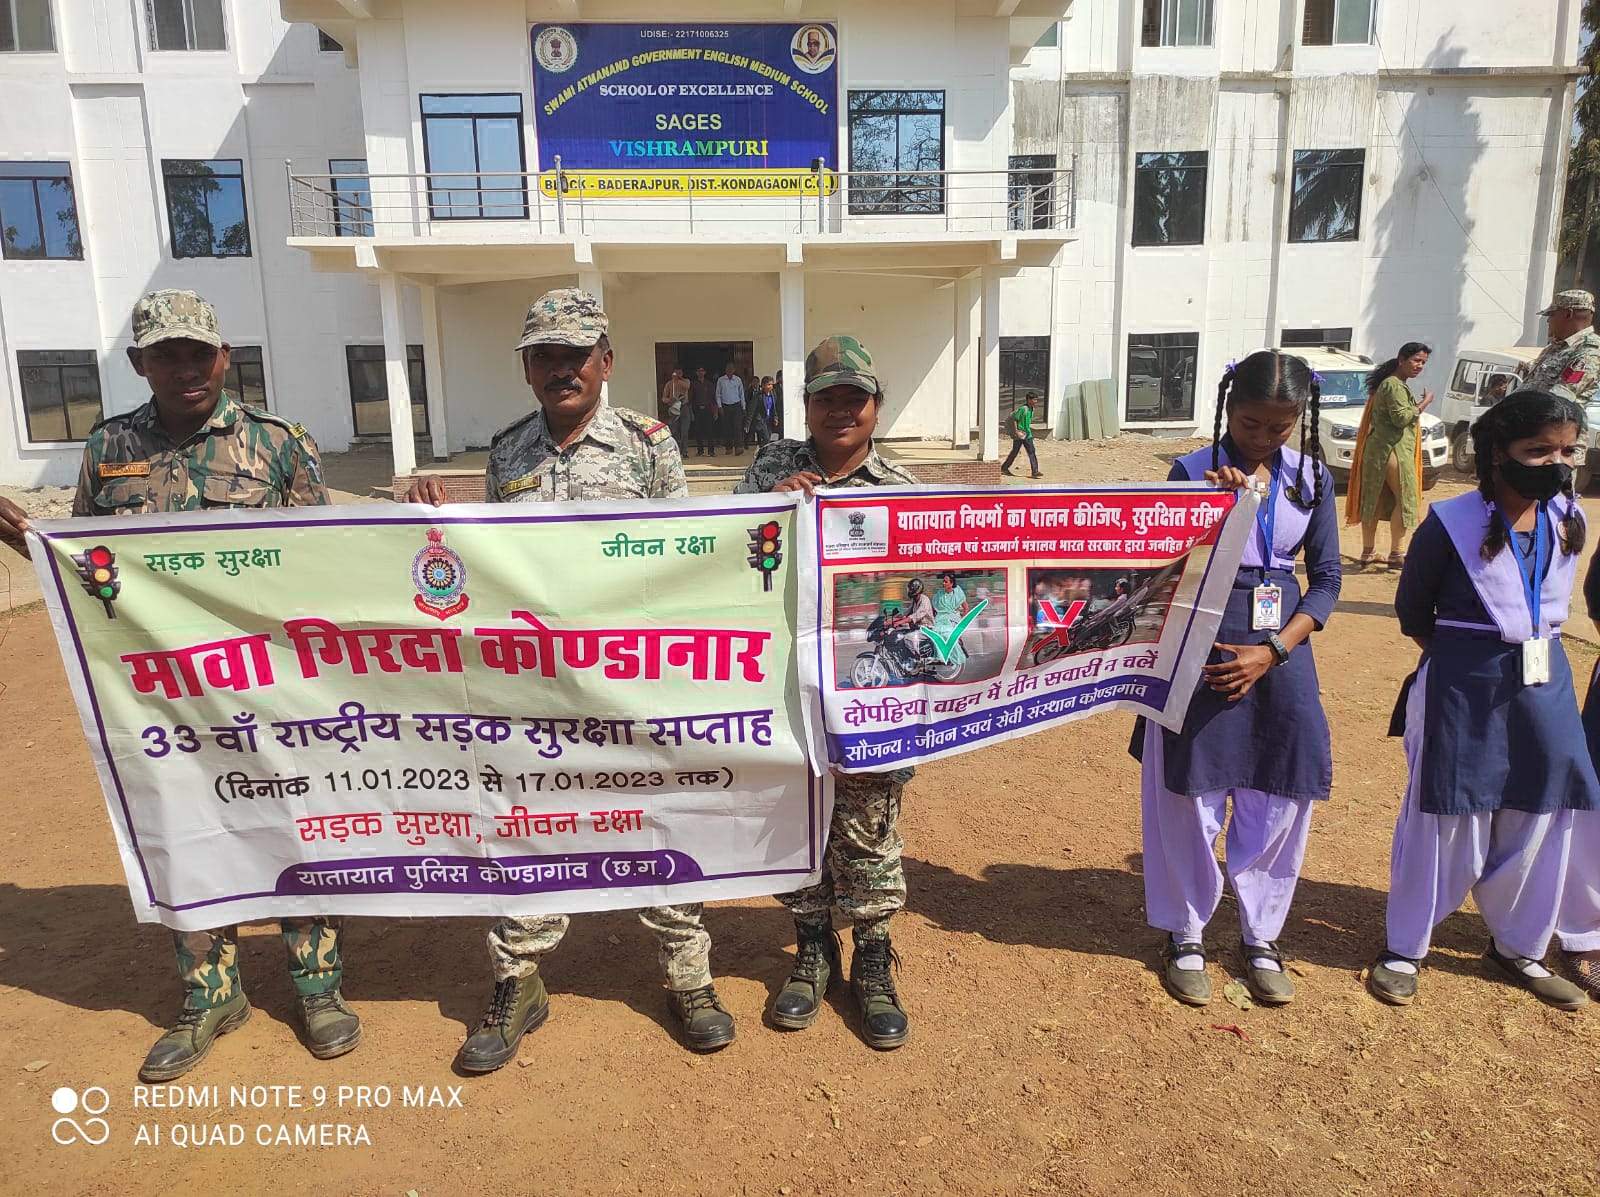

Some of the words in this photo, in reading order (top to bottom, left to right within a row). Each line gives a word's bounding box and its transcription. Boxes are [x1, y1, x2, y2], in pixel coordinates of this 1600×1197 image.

[544, 86, 576, 116] SWAMI
[576, 58, 631, 93] ATMANAND
[631, 48, 701, 68] GOVERNMENT
[703, 50, 750, 68] ENGLISH
[749, 59, 791, 86] MEDIUM
[789, 80, 830, 115] SCHOOL
[599, 84, 656, 97] SCHOOL
[657, 84, 677, 97] OF
[678, 84, 774, 97] EXCELLENCE
[655, 113, 722, 131] SAGES
[608, 139, 769, 157] VISHRAMPURI
[545, 179, 586, 190] BLCK
[897, 510, 956, 531] यातायात
[959, 503, 1004, 529] नियमों
[1007, 508, 1027, 528] का
[1030, 508, 1069, 528] पालन
[1073, 502, 1127, 531] कीजिए,
[1132, 502, 1187, 535] सुरक्षित
[143, 551, 205, 576] सड़क
[215, 548, 281, 576] सुरक्षा
[601, 532, 666, 558] जीवन
[675, 535, 717, 556] रक्षा
[898, 542, 924, 557] सड़क
[925, 539, 961, 556] परिवहन
[982, 536, 1019, 553] राजमार्ग
[1059, 539, 1085, 552] भारत
[1088, 539, 1121, 552] सरकार
[1124, 539, 1145, 554] द्वारा
[1147, 536, 1184, 554] जनहित
[120, 632, 275, 699] मावा
[283, 617, 464, 679] गिरदा
[474, 610, 772, 683] कोण्डानार
[843, 696, 928, 726] दोपहिया
[934, 691, 983, 713] वाहन
[987, 680, 1003, 700] में
[1007, 673, 1039, 697] तीन
[1044, 657, 1103, 687] सवारी
[1104, 658, 1118, 672] न
[1123, 649, 1160, 669] चलें
[141, 724, 202, 758] 33
[211, 711, 258, 753] वाँ
[271, 701, 401, 753] राष्ट्रीय
[412, 713, 511, 752] सड़क
[521, 716, 635, 759] सुरक्षा
[647, 709, 774, 747] सप्ताह
[845, 738, 903, 761] सौजन्य
[915, 727, 958, 749] जीवन
[961, 713, 993, 738] स्वयं
[995, 705, 1024, 728] सेवी
[1027, 696, 1077, 719] संस्थान
[1079, 679, 1149, 705] कोण्डागांव
[215, 771, 310, 803] (दिनांक
[324, 768, 471, 793] 11.01.2023
[480, 765, 503, 793] से
[515, 770, 665, 793] 17.01.2023
[676, 766, 735, 789] तक)
[296, 811, 382, 844] सड़क
[393, 811, 483, 846] सुरक्षा,
[494, 805, 579, 838] जीवन
[590, 808, 644, 834] रक्षा
[297, 866, 394, 887] यातायात
[403, 858, 469, 890] पुलिस
[478, 857, 588, 885] कोण्डागांव
[602, 854, 676, 882] (छ.ग.)
